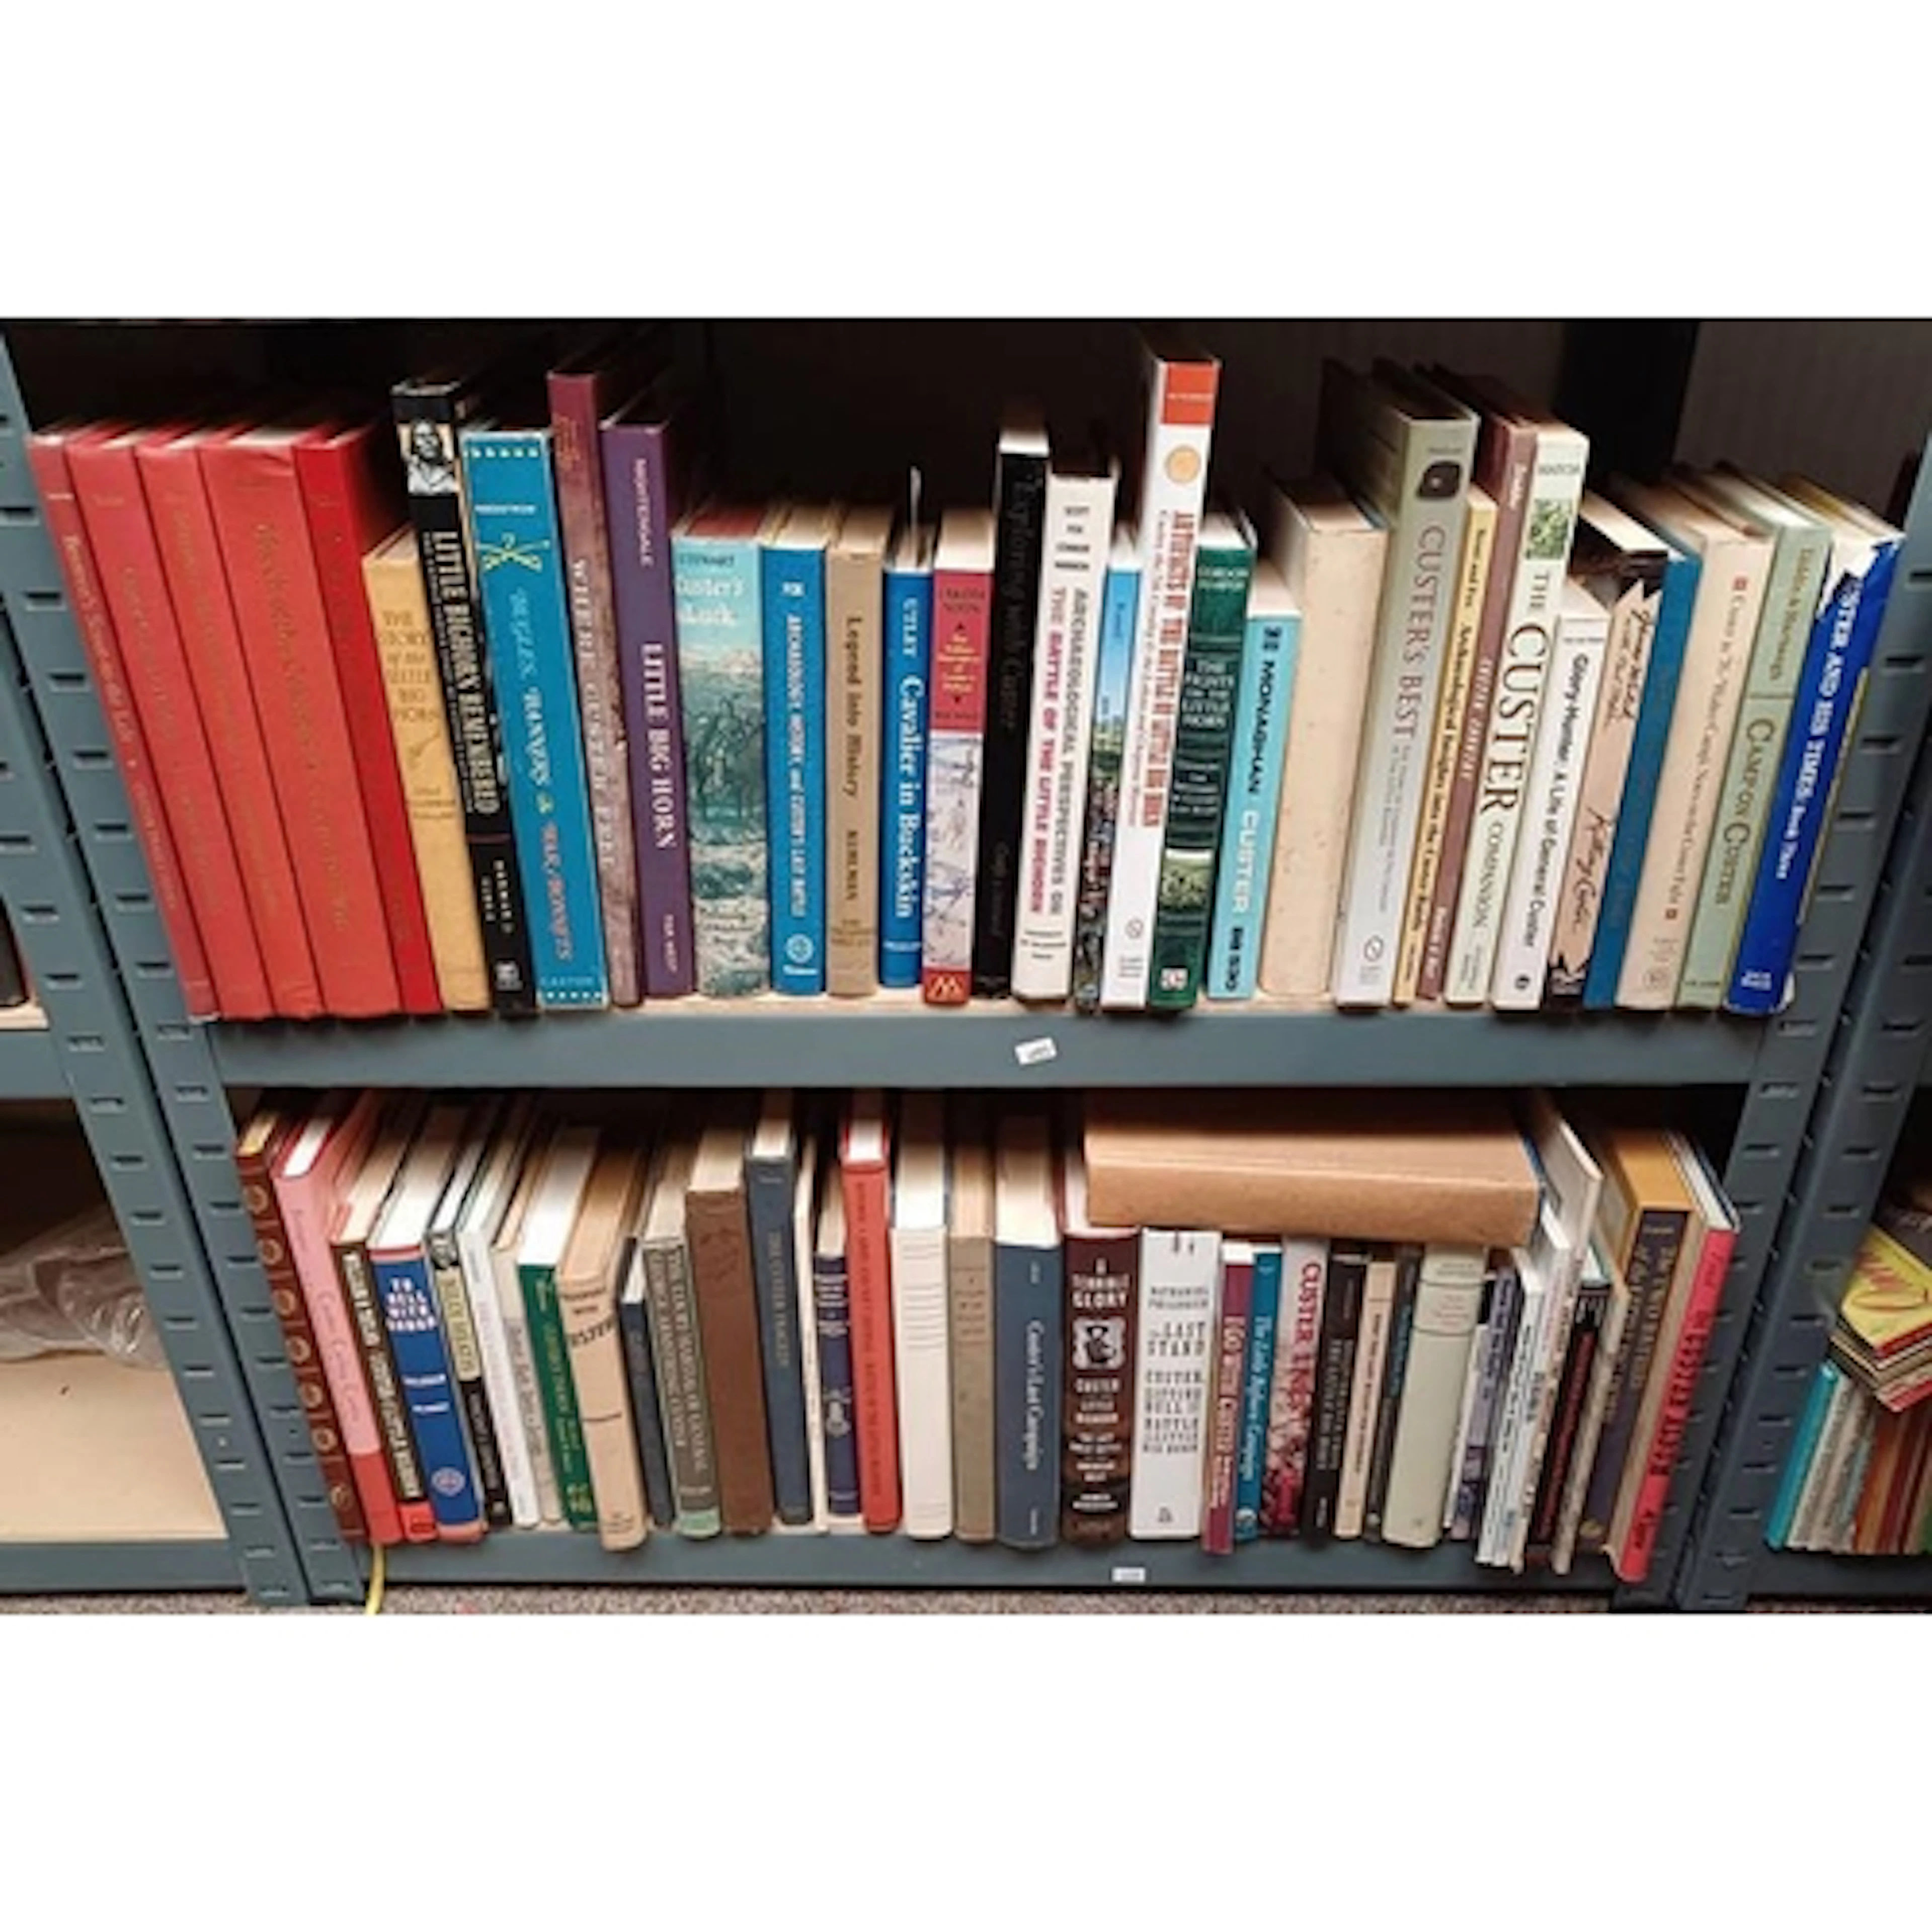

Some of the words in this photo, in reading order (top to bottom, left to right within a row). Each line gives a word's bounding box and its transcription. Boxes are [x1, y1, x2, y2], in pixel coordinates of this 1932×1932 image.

[568, 557, 597, 665] WHERE
[1049, 586, 1067, 625] THE
[1400, 523, 1446, 666] CUSTER'S
[1526, 571, 1550, 613] THE
[1828, 576, 1864, 652] USTER
[844, 617, 863, 685] Legend
[901, 598, 918, 657] UTLEY
[431, 528, 468, 600] LITTLE
[456, 690, 503, 815] REMEMBERED
[639, 642, 669, 724] LITTLE
[1043, 630, 1064, 701] BATTLE
[1061, 588, 1088, 754] ARCHAEOLOGICAL
[1442, 622, 1472, 730] Archaeological
[1817, 652, 1843, 698] AND
[845, 693, 862, 728] into
[897, 675, 923, 774] Cavalier
[1041, 707, 1058, 734] OF
[1246, 660, 1276, 794] MONAGHAN
[1391, 673, 1426, 741] BEST
[1477, 620, 1549, 821] CUSTER
[1809, 699, 1832, 738] HIS
[646, 728, 672, 772] BIG
[843, 734, 861, 798] History
[1038, 736, 1056, 771] THE
[649, 777, 676, 849] HORN
[898, 782, 921, 805] in
[1034, 775, 1053, 832] LITTLE
[1050, 760, 1074, 884] PERSPECTIVES
[1545, 786, 1564, 817] Life
[895, 813, 920, 918] Buckskin
[1028, 837, 1049, 914] BIGHORN
[1232, 809, 1260, 914] CUSTER
[1470, 819, 1508, 931] COMPANION
[1532, 837, 1555, 897] General
[1048, 891, 1062, 914] ON
[1522, 899, 1545, 948] Custer
[1163, 1321, 1206, 1338] LAST
[1253, 1315, 1273, 1338] The
[1293, 1262, 1322, 1345] CUSTER
[1025, 1320, 1045, 1376] Custer's
[1148, 1339, 1205, 1357] STAND
[1026, 1379, 1042, 1404] Last
[1023, 1407, 1043, 1471] Campaign
